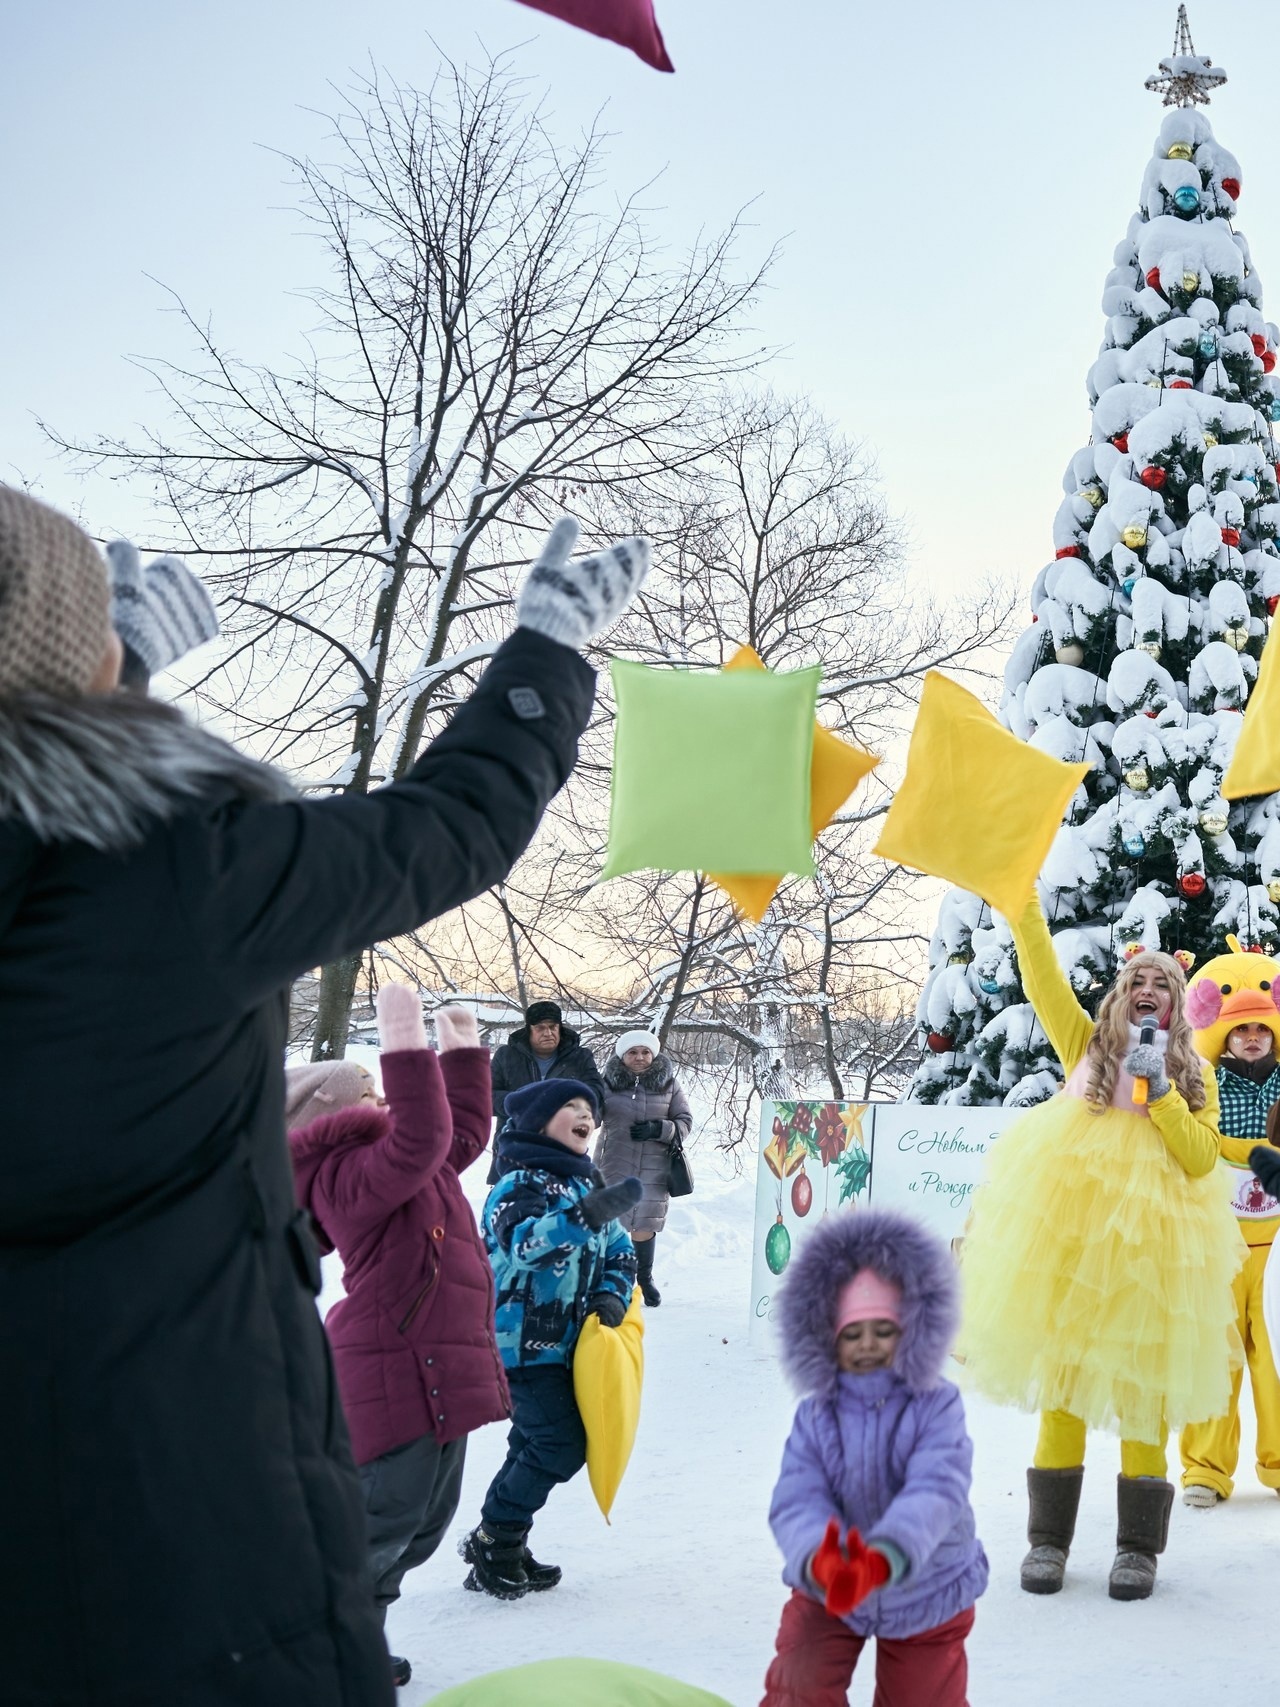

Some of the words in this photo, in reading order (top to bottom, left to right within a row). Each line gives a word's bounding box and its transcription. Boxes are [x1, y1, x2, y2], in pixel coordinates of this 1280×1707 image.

[897, 1129, 919, 1152] С
[917, 1126, 987, 1155] Новым
[908, 1181, 920, 1192] и
